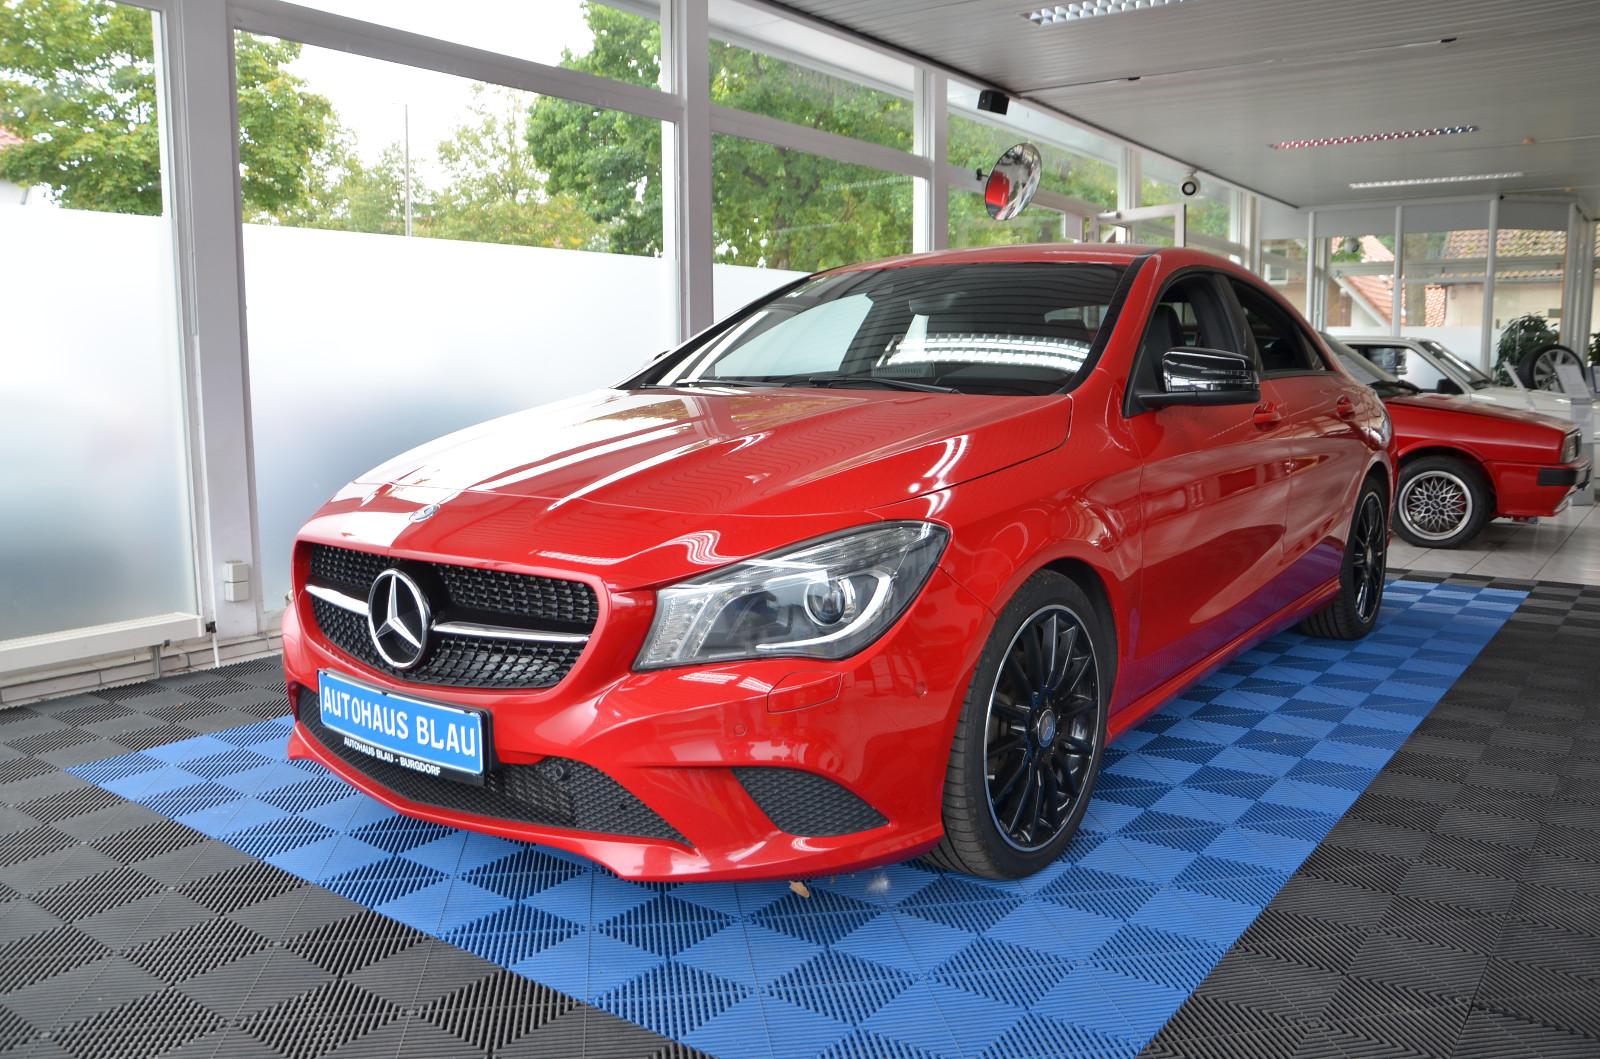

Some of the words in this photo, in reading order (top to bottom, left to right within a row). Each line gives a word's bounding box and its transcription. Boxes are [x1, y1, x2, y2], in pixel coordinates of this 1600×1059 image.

[323, 686, 409, 740] AUTOHAUS
[416, 716, 476, 757] BLAU
[344, 737, 375, 756] AUTOHAUS
[376, 748, 394, 764] BLAU
[400, 756, 441, 776] BURGDORF
